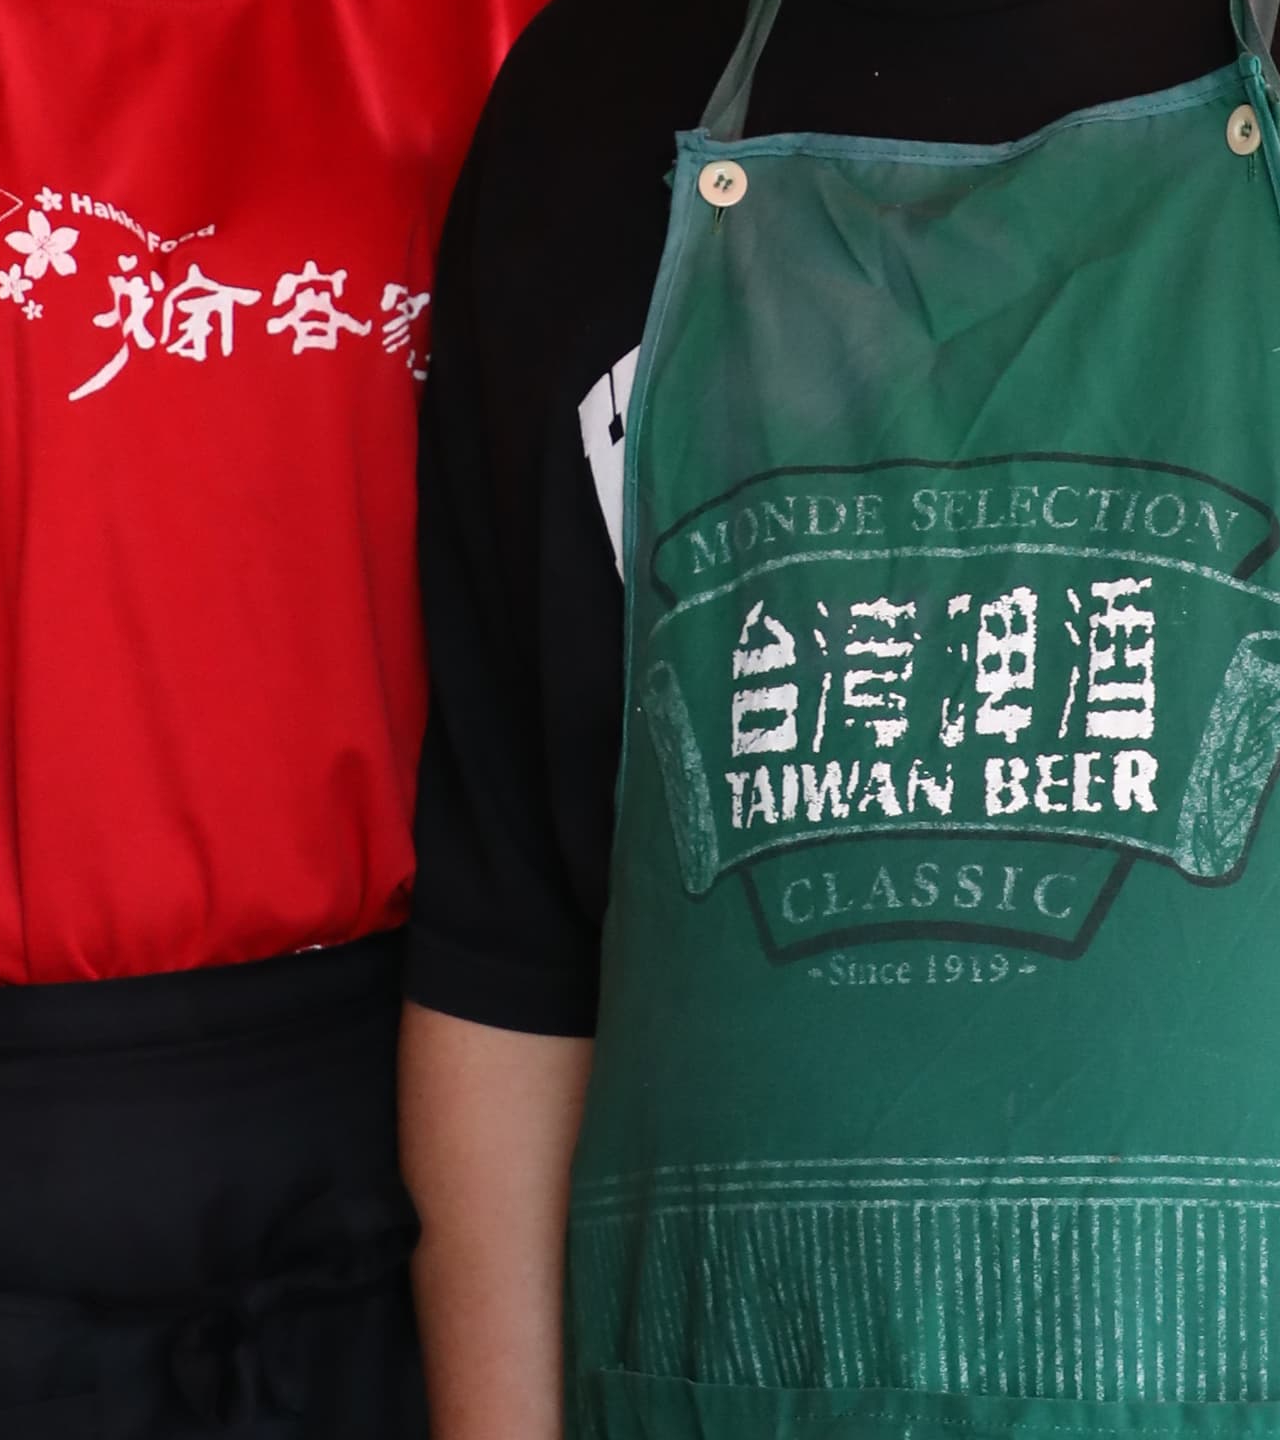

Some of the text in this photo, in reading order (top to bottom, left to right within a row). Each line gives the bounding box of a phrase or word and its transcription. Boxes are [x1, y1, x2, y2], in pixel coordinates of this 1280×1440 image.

[690, 484, 1240, 574] MONDE SELECTION
[724, 748, 1159, 829] TAIWAN BEER
[781, 862, 1077, 924] CLASSIC
